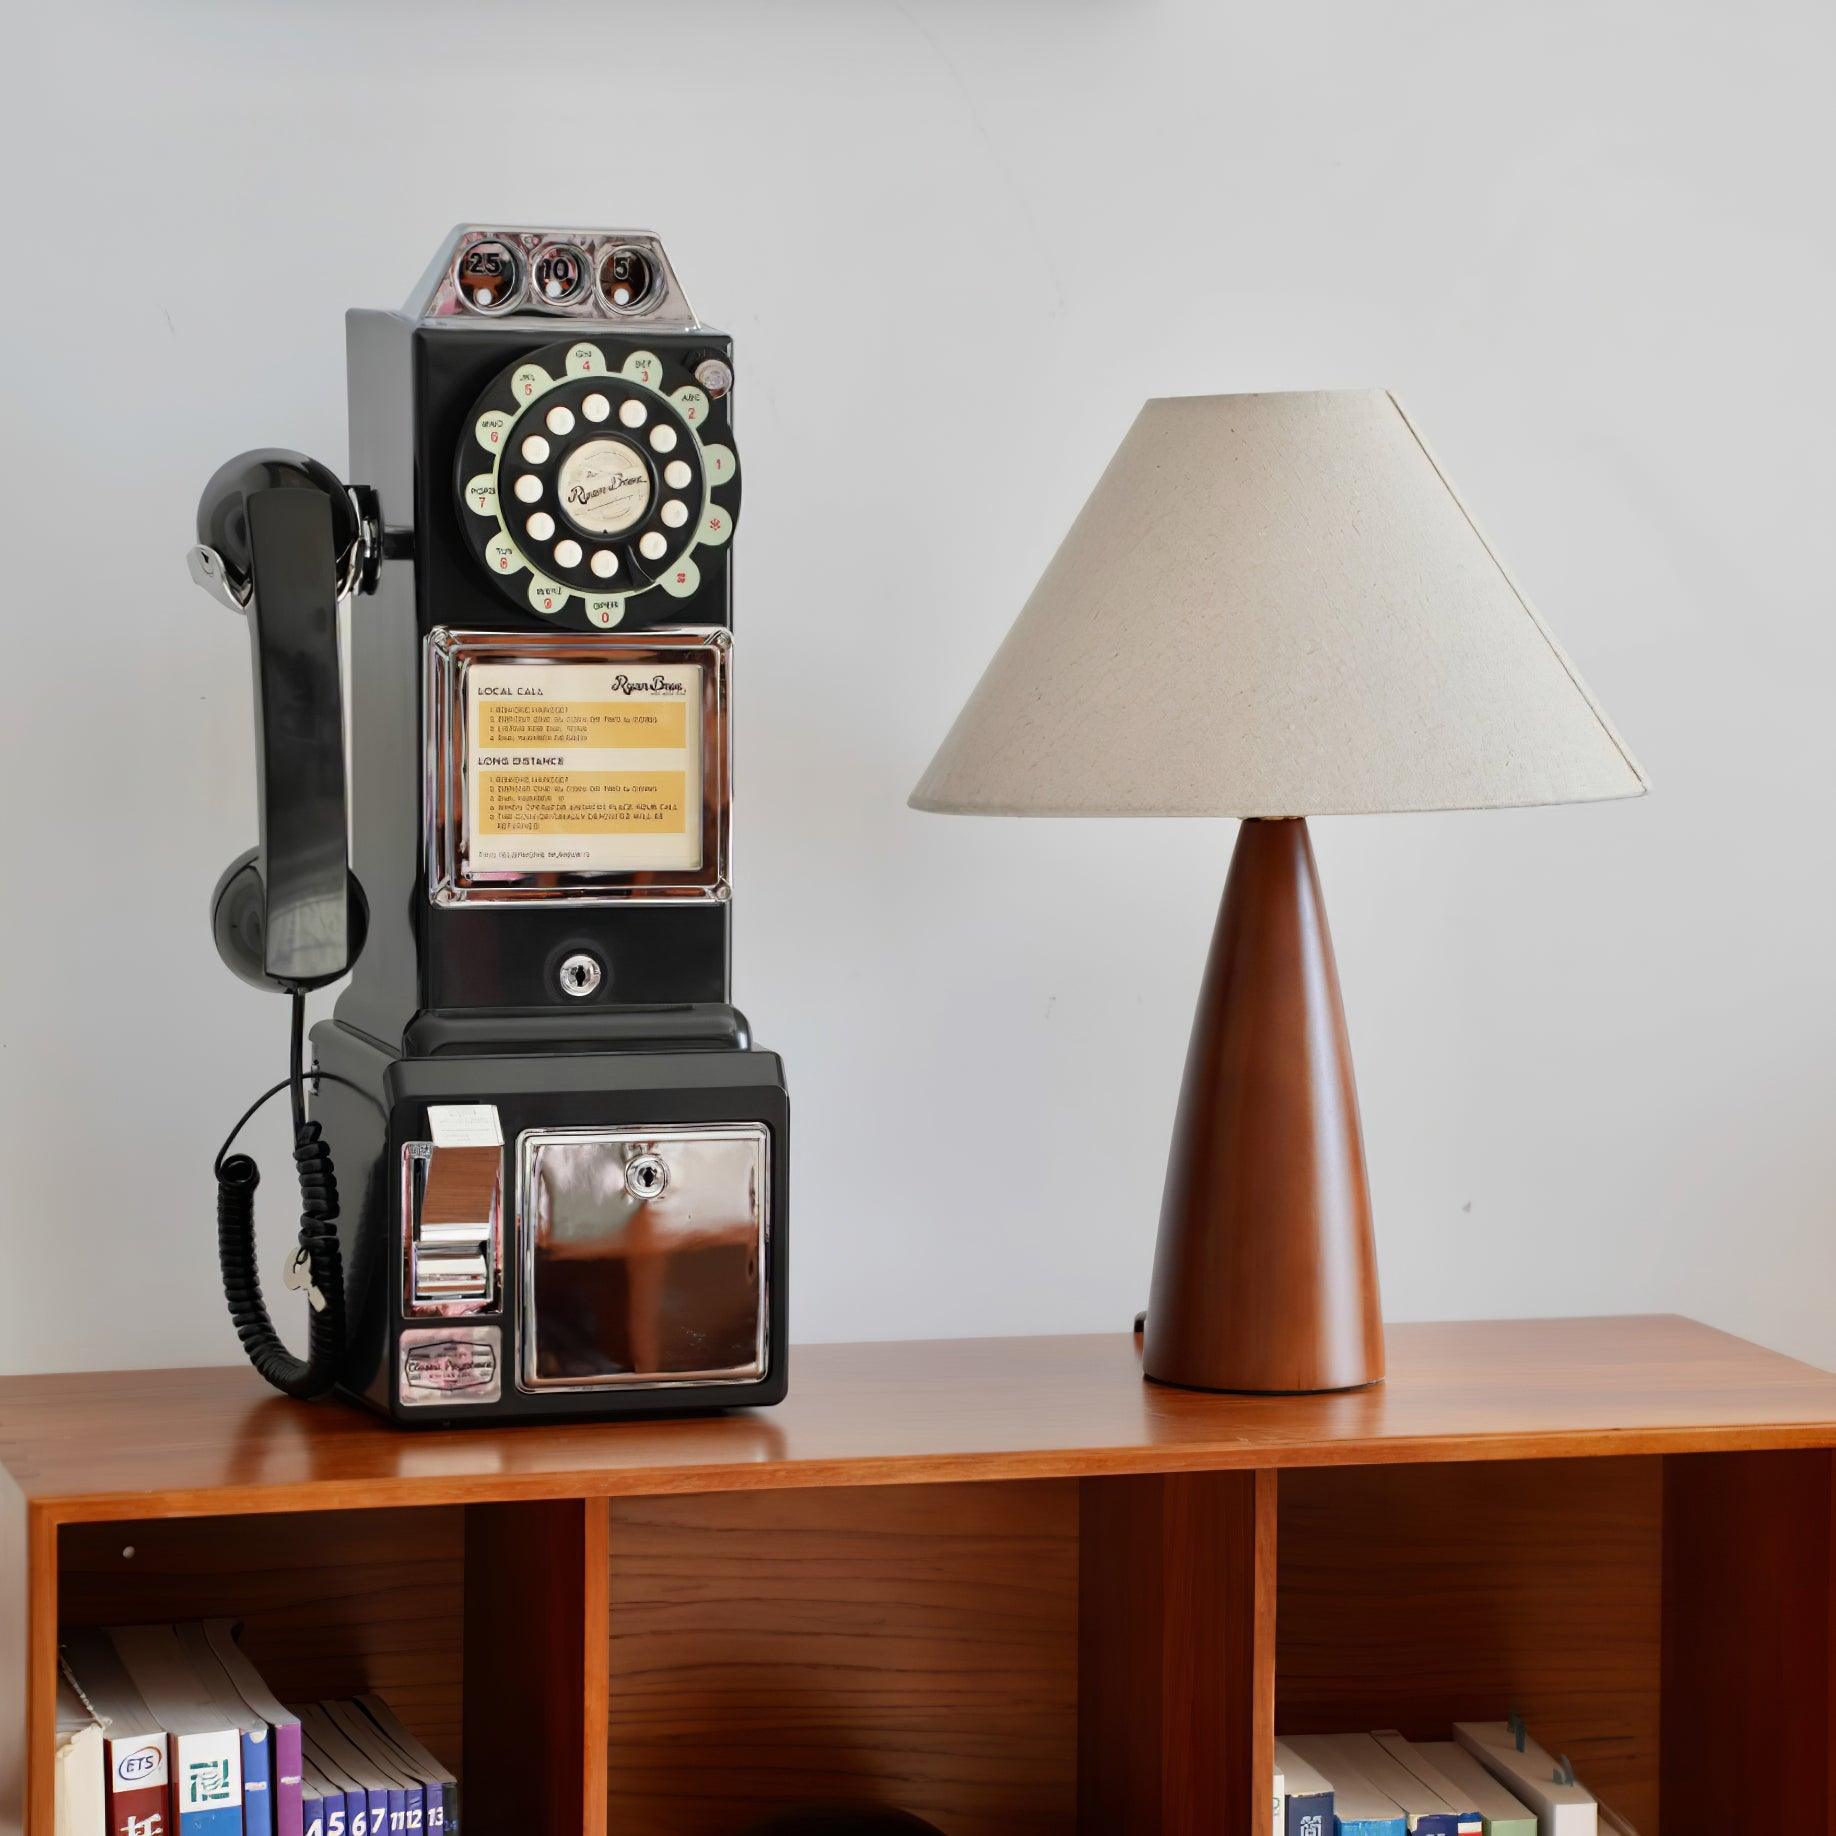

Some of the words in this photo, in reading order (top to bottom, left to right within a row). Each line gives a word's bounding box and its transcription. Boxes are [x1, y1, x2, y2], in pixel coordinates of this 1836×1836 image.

[469, 252, 501, 275] 25
[543, 257, 569, 280] 10
[613, 257, 630, 279] 5
[582, 360, 591, 371] 4
[641, 371, 649, 384] 3
[688, 407, 696, 419] 2
[490, 431, 499, 443] 6
[478, 497, 486, 509] 7
[477, 687, 513, 696] LOCAL
[477, 757, 509, 766] LONG
[126, 1755, 154, 1773] ETS
[328, 1811, 345, 1836] 5
[351, 1811, 367, 1836] 6
[371, 1808, 386, 1834] 7
[390, 1811, 405, 1831] 11
[406, 1809, 423, 1829] 12
[428, 1807, 443, 1826] 13
